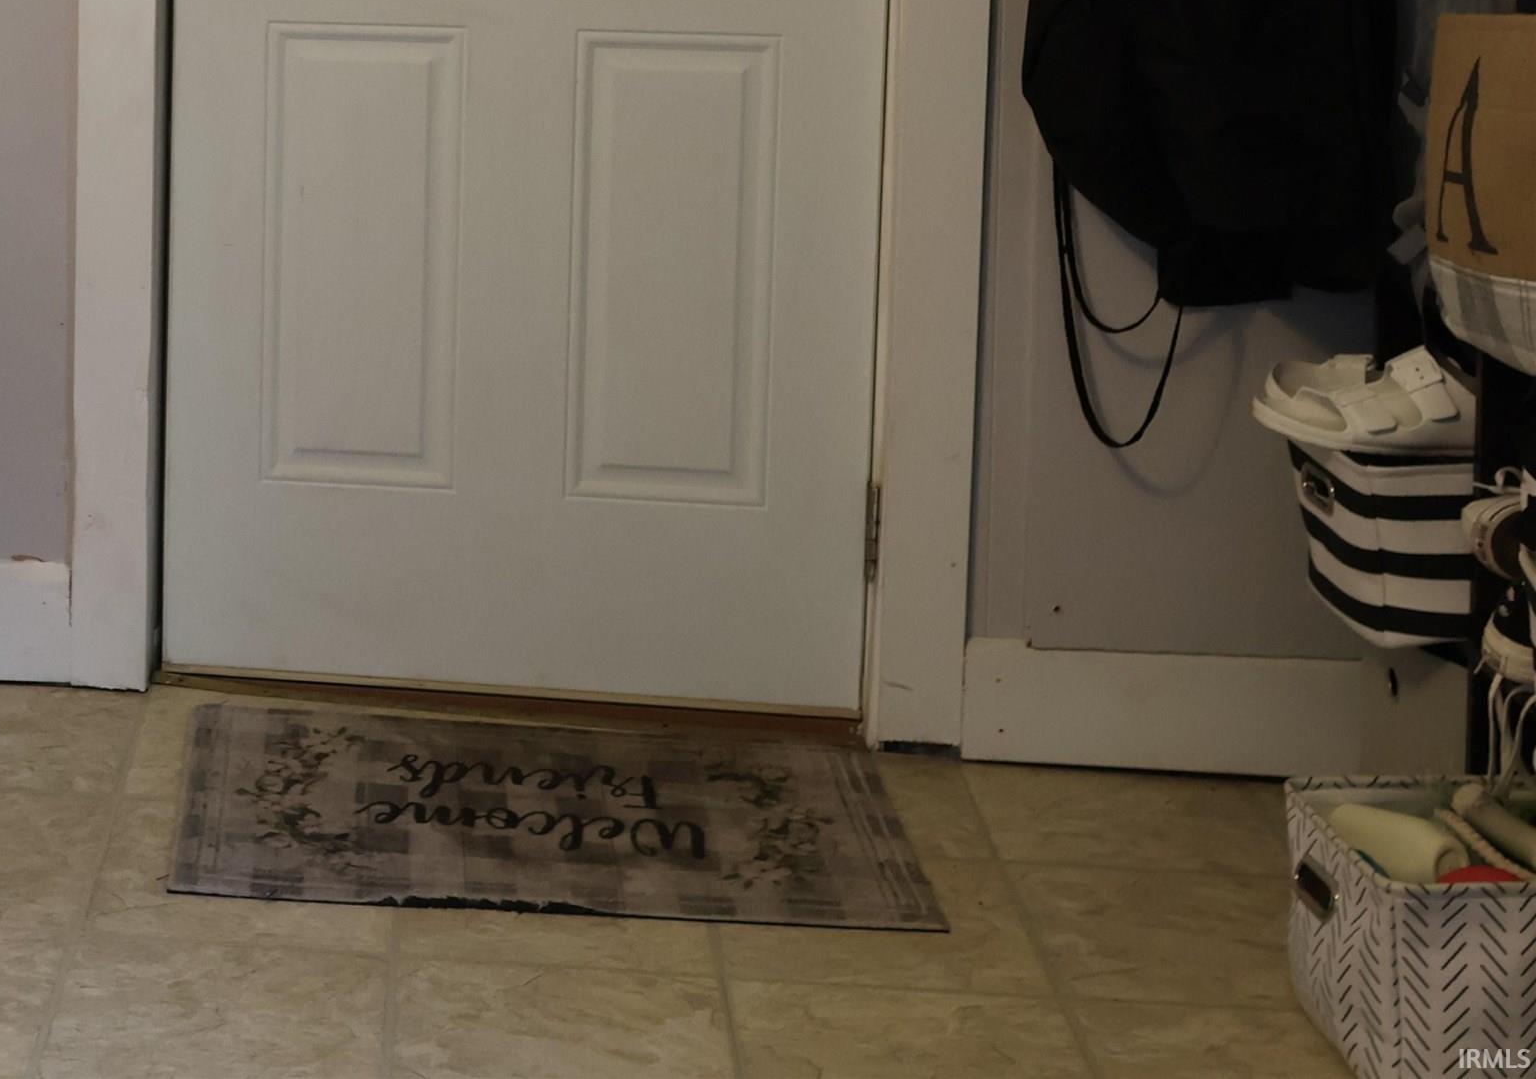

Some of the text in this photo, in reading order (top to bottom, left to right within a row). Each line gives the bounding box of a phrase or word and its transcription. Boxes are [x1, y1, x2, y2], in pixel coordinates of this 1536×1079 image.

[1435, 55, 1499, 256] A
[386, 753, 662, 811] Friends
[355, 801, 706, 862] Welcome
